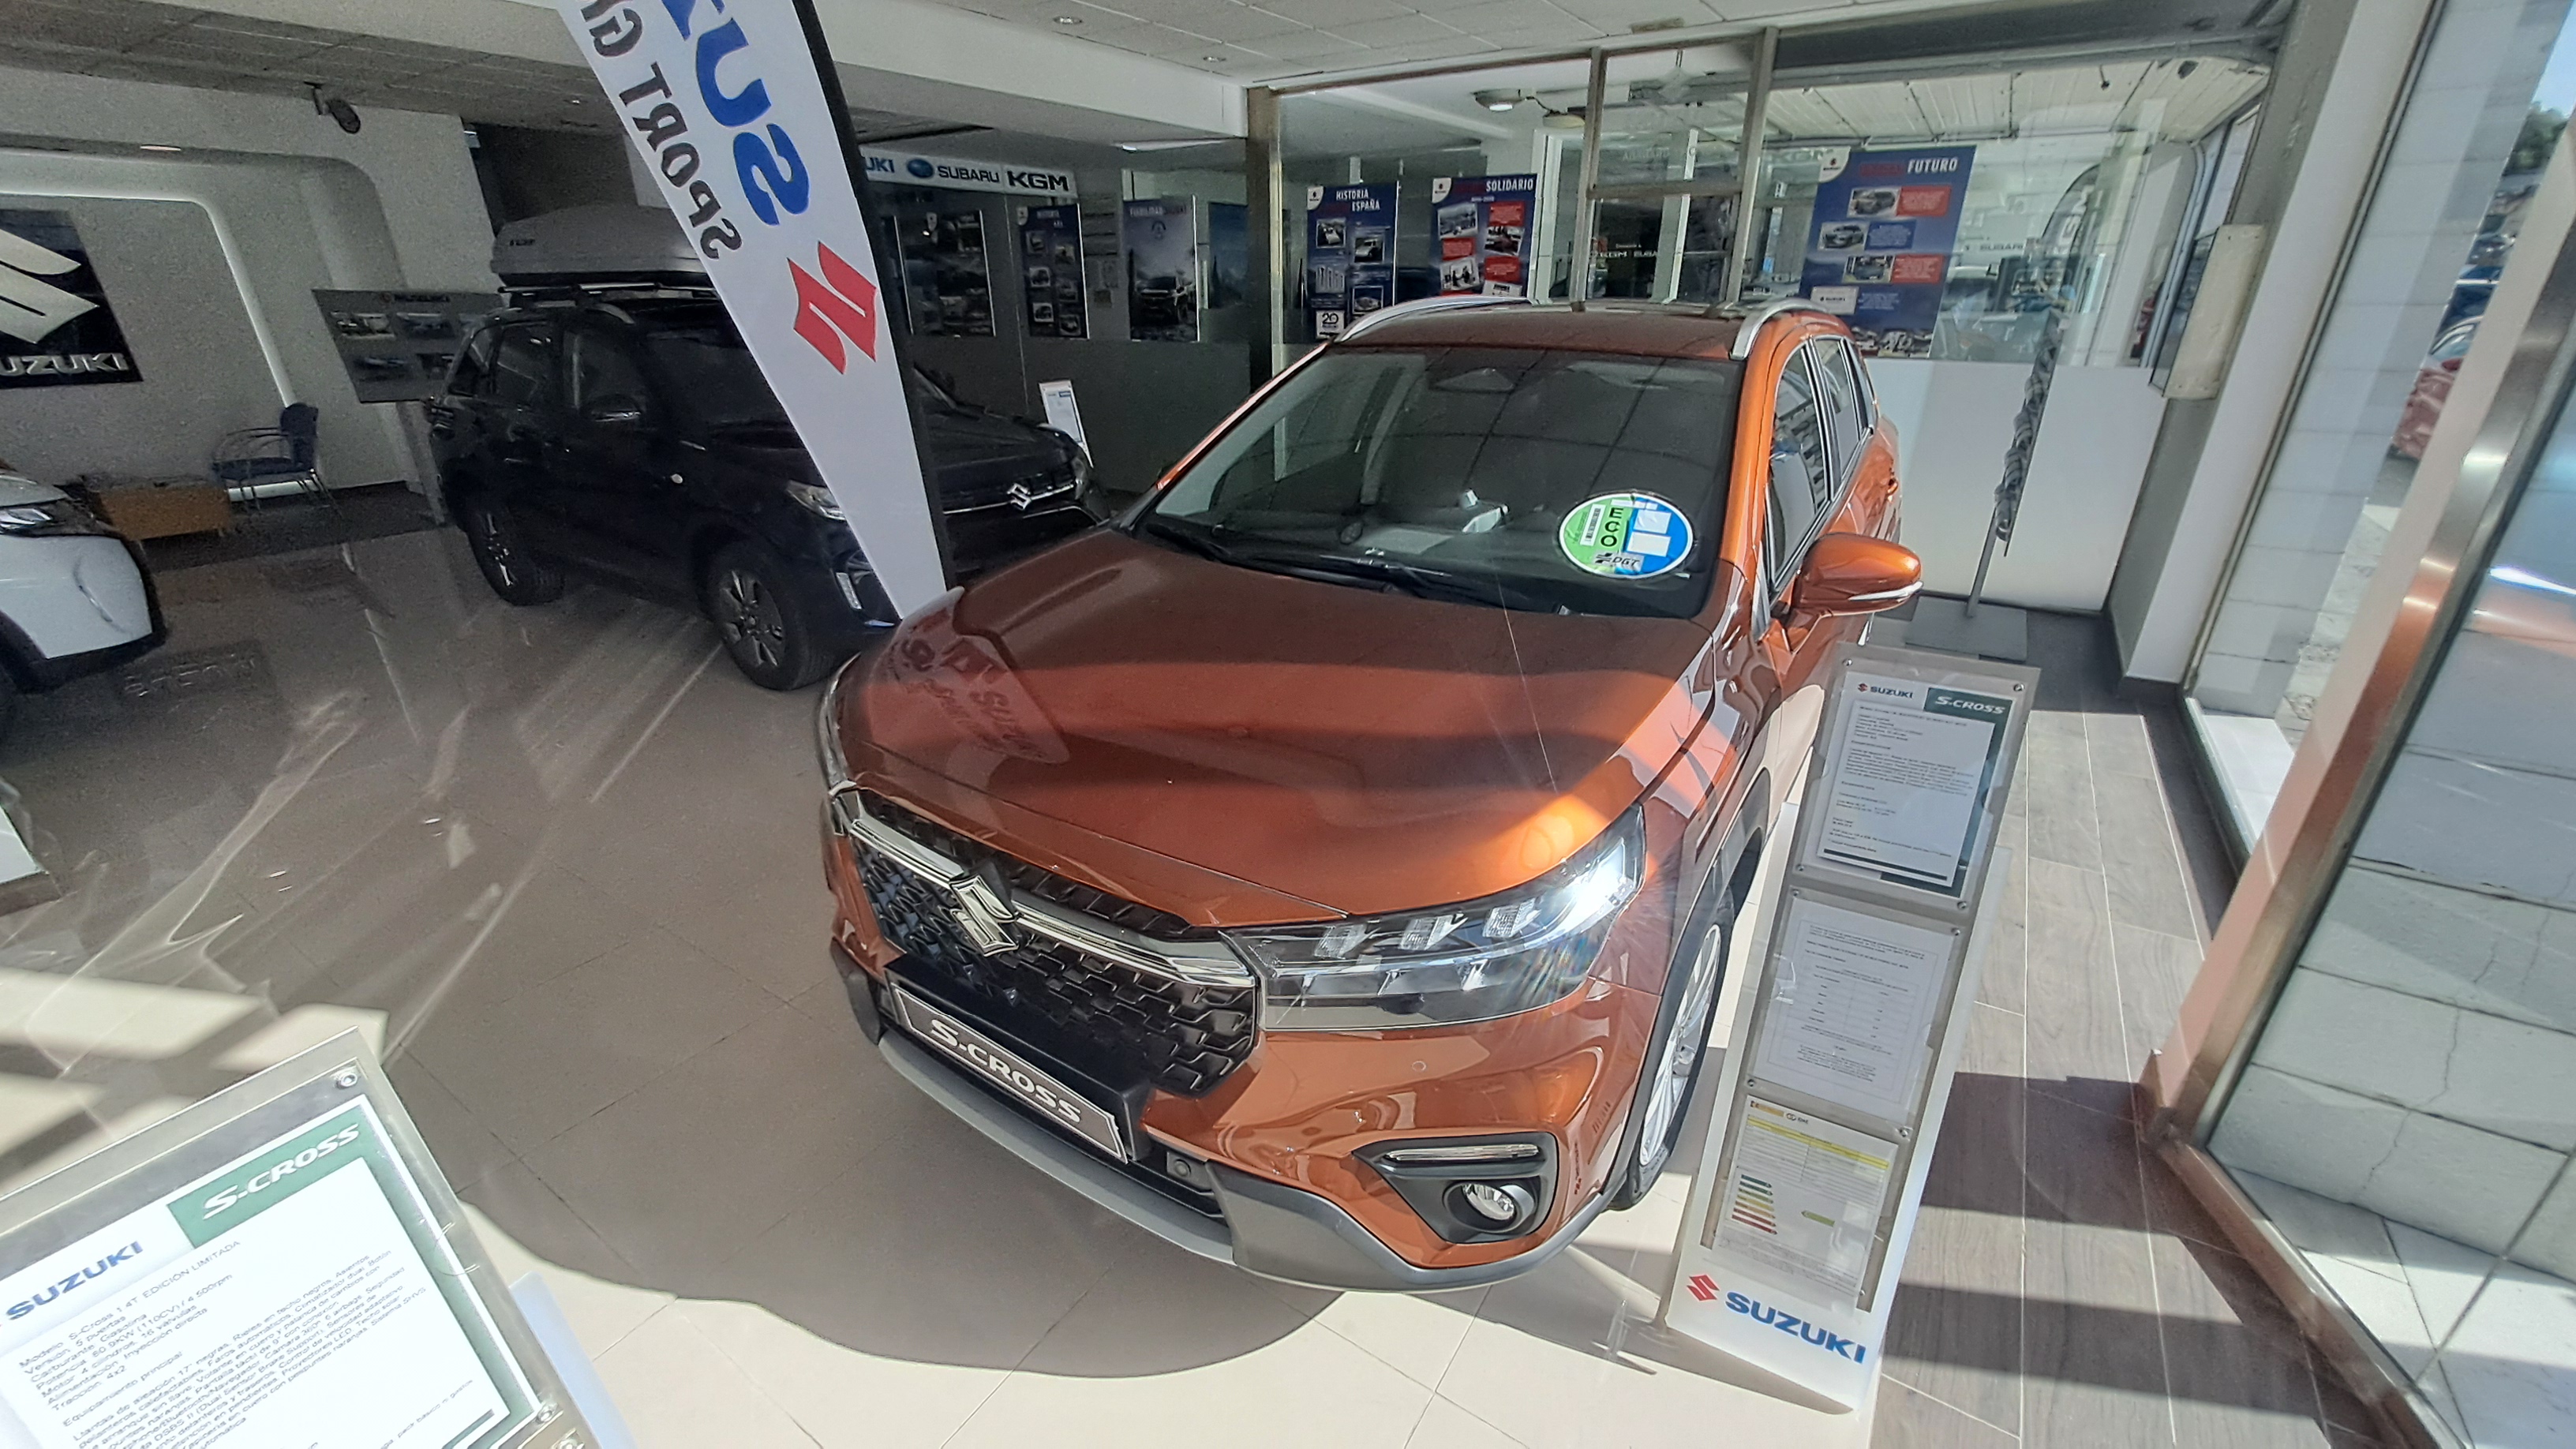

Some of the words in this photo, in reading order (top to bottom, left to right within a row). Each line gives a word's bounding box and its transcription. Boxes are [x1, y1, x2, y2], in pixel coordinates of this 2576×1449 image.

[938, 166, 999, 183] SUBARU
[1907, 157, 1958, 174] FUTURO
[1006, 170, 1069, 191] KGM
[1486, 178, 1533, 192] SOLIDARIO
[1336, 189, 1369, 200] HISTORIA
[1352, 199, 1380, 212] ESPAÑA
[0, 353, 129, 376] UZUKI
[1601, 507, 1624, 547] ECO
[1612, 556, 1641, 567] DGT
[1870, 685, 1914, 699] SUZUKI
[1934, 695, 2006, 715] S-CROSS
[930, 1018, 1082, 1125] S-CROSS
[203, 1123, 360, 1220] S-CROSS
[6, 1240, 144, 1320] SUZUKI
[67, 1311, 114, 1340] S-Cross
[116, 1296, 140, 1312] 14T
[191, 1238, 241, 1271] LIMITADA
[186, 1271, 234, 1303] 4500rpm
[85, 1314, 127, 1342] puertas
[99, 1312, 147, 1343] Gasolina
[1724, 1291, 1867, 1365] SUZUKI
[248, 1332, 275, 1351] cuero
[105, 1364, 126, 1380] 4x2
[199, 1416, 247, 1449] utomática
